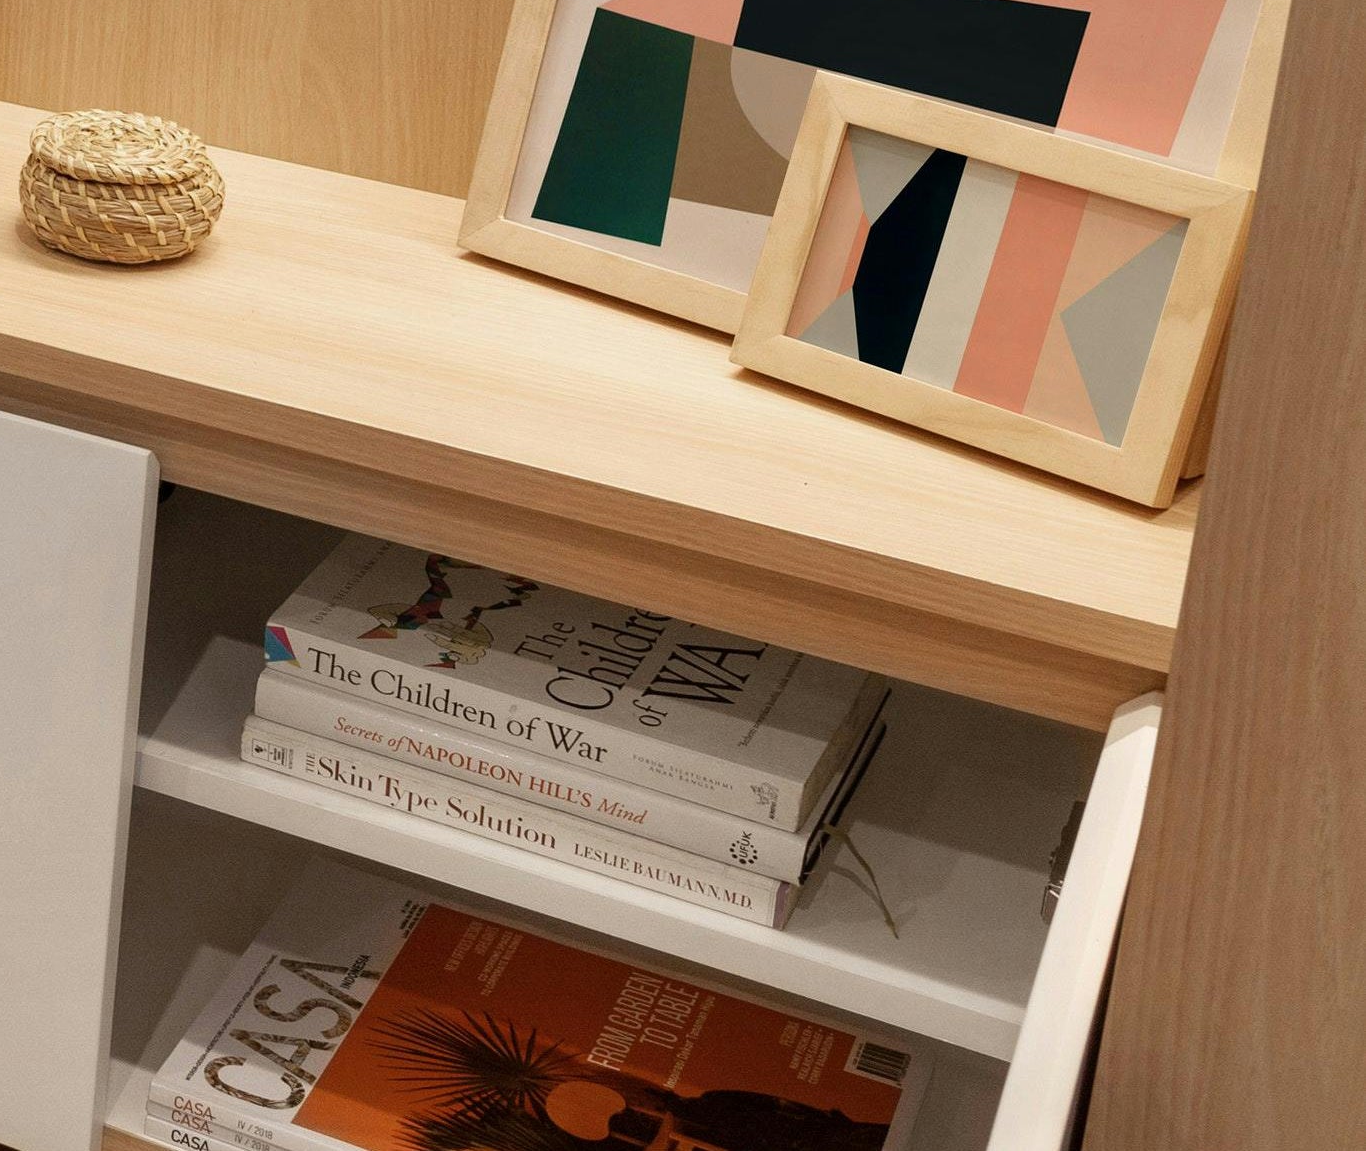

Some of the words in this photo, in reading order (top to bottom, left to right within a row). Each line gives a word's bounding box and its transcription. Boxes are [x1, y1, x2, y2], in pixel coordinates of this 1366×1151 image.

[514, 620, 576, 660] The
[546, 607, 672, 710] Childre
[641, 629, 768, 705] WA
[307, 646, 362, 687] The
[370, 668, 497, 731] Children
[506, 716, 541, 741] of
[545, 719, 609, 765] War
[632, 698, 668, 728] of
[333, 716, 383, 745] Secrets
[387, 735, 410, 753] of
[406, 741, 524, 788] NAPOLEON
[528, 774, 593, 809] HILL'S
[596, 799, 649, 825] Mind
[305, 752, 316, 772] THE
[316, 756, 374, 792] Skin
[378, 773, 439, 813] Type
[445, 795, 558, 850] Solution
[574, 842, 630, 871] LESLIE
[738, 830, 753, 859] UFUK
[339, 954, 371, 990] INDONESIA
[608, 972, 664, 1029] GARDEN
[649, 982, 699, 1029] TABLE
[203, 957, 382, 1110] CASA
[587, 1025, 637, 1071] FROM
[639, 1026, 678, 1049] TO
[170, 1129, 210, 1151] CASA
[171, 1109, 213, 1134] CASA
[173, 1096, 216, 1121] CASA
[237, 1120, 246, 1130] IV
[253, 1126, 273, 1140] 2018
